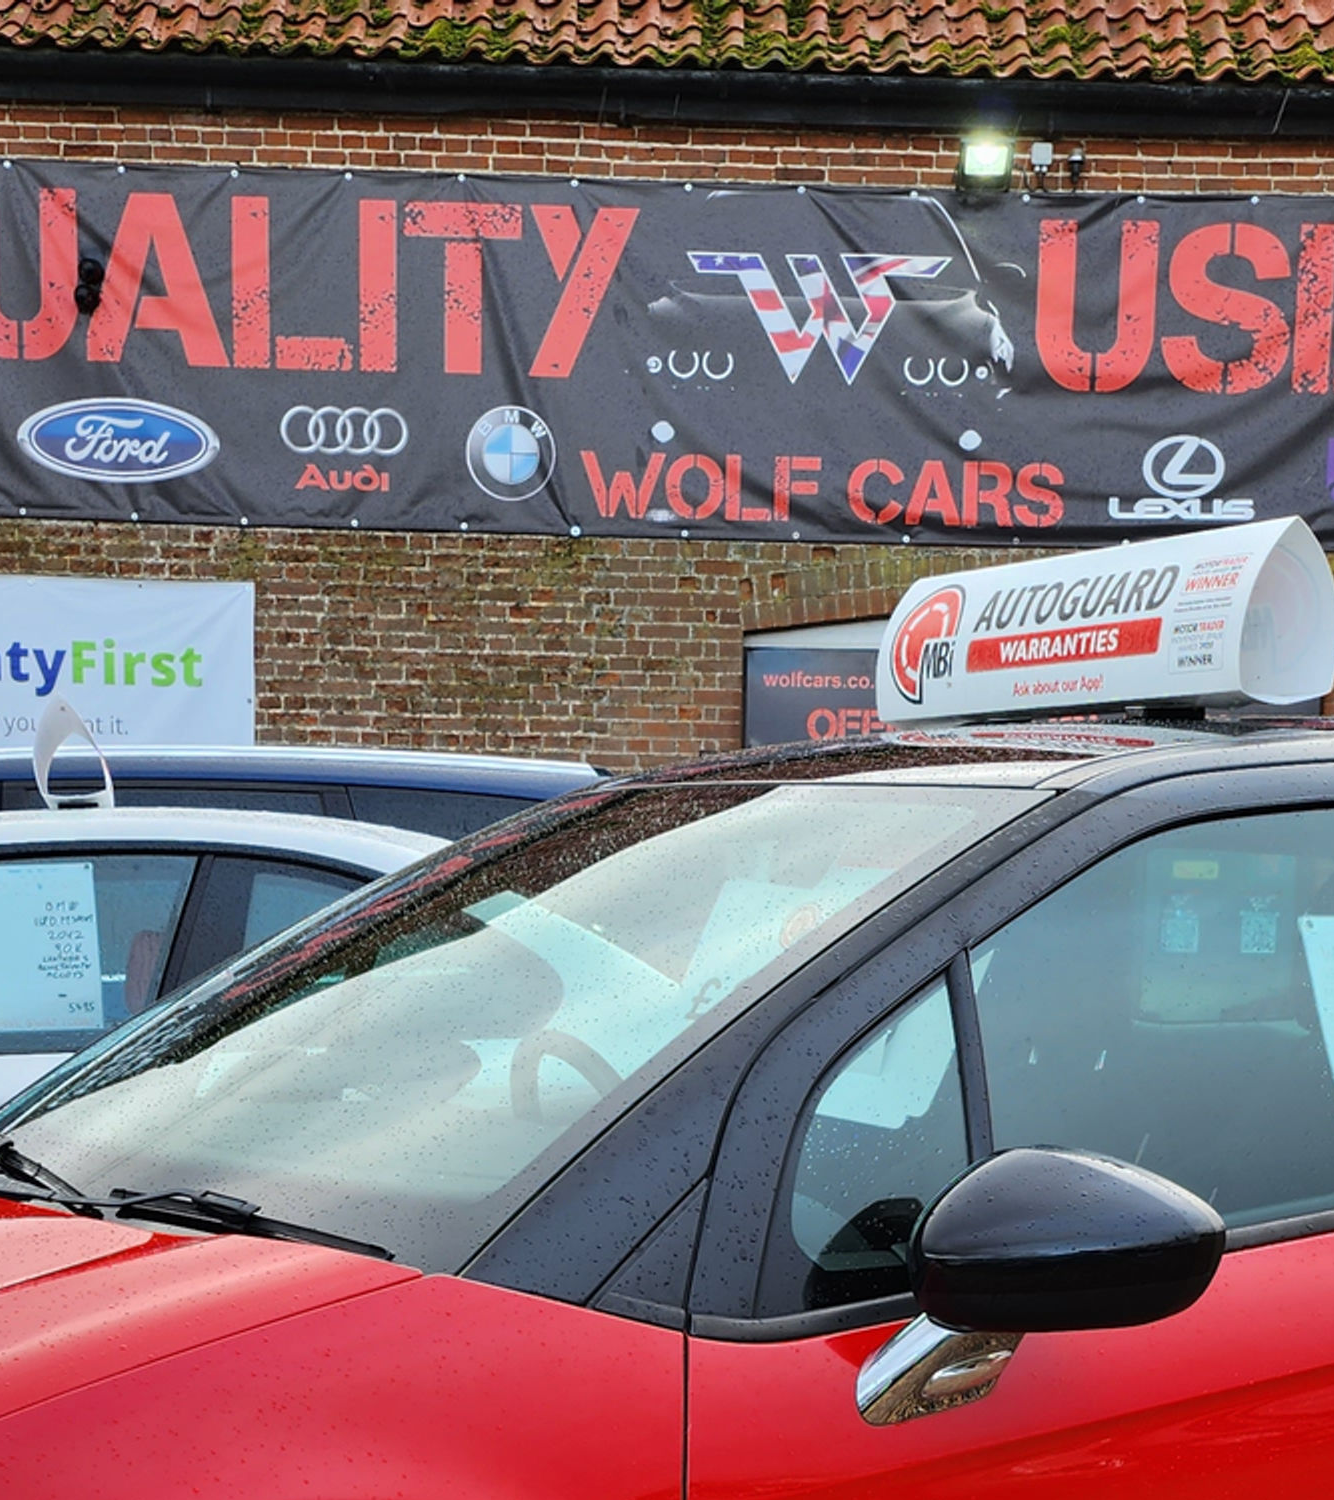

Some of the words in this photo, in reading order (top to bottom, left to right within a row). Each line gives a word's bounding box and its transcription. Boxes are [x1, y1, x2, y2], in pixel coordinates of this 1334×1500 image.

[477, 409, 547, 439] BMW
[65, 415, 172, 467] Ford
[294, 464, 391, 493] Audi
[580, 449, 824, 523] WOLF
[849, 456, 1066, 529] CARS
[1108, 496, 1255, 522] LEXUS
[1185, 571, 1240, 592] WINNER
[973, 564, 1179, 634] AUTOGUARD
[999, 627, 1120, 664] WARRANTIES
[762, 670, 876, 689] wolfcars.co.
[1012, 681, 1030, 697] Ask
[1032, 678, 1061, 695] about
[1062, 679, 1078, 691] our
[1079, 673, 1104, 692] App!
[110, 715, 130, 736] it.
